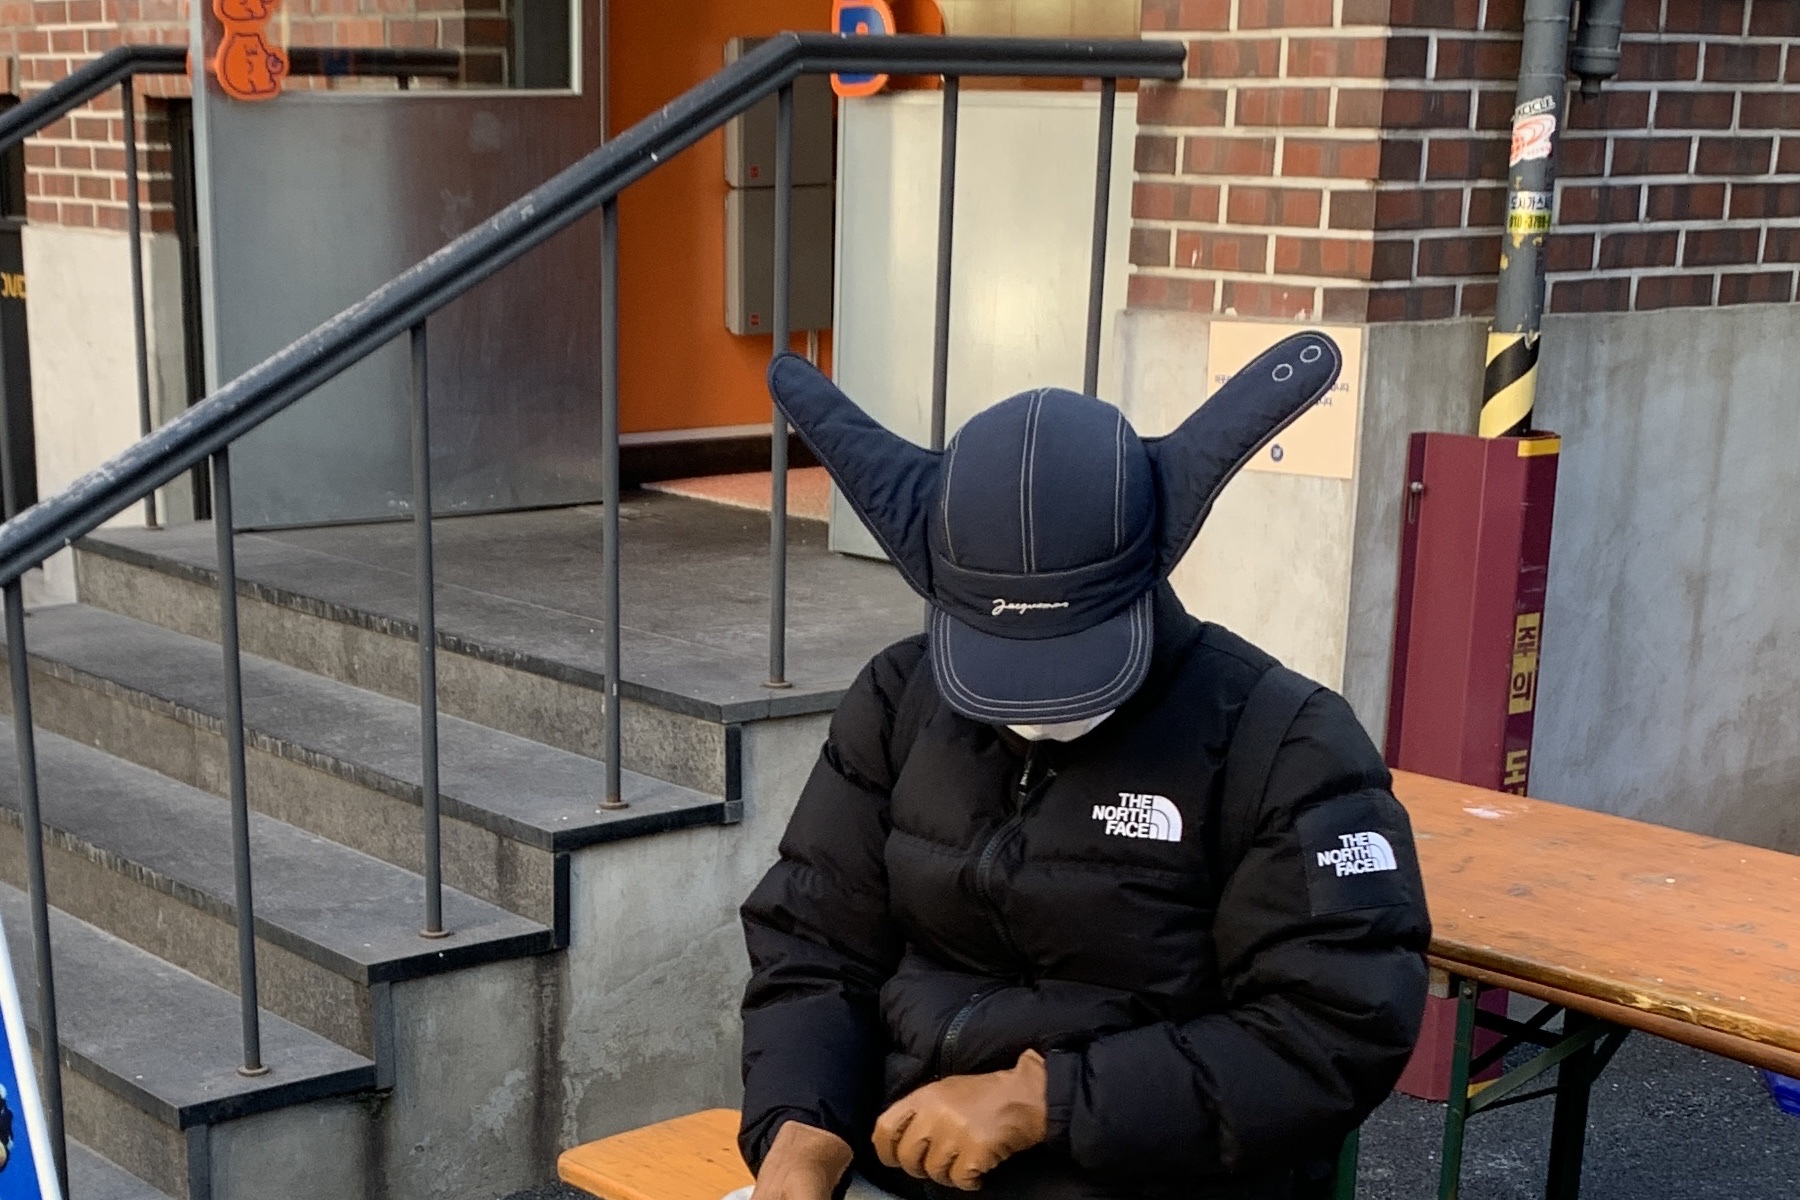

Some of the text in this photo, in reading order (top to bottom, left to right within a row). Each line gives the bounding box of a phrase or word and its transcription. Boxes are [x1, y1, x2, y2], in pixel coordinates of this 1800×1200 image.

[1118, 792, 1153, 809] THE
[1091, 804, 1151, 824] NORTH
[1105, 820, 1150, 839] FACE
[1338, 831, 1370, 848] THE
[1317, 844, 1373, 868] NORTH
[1335, 858, 1377, 877] FACE
